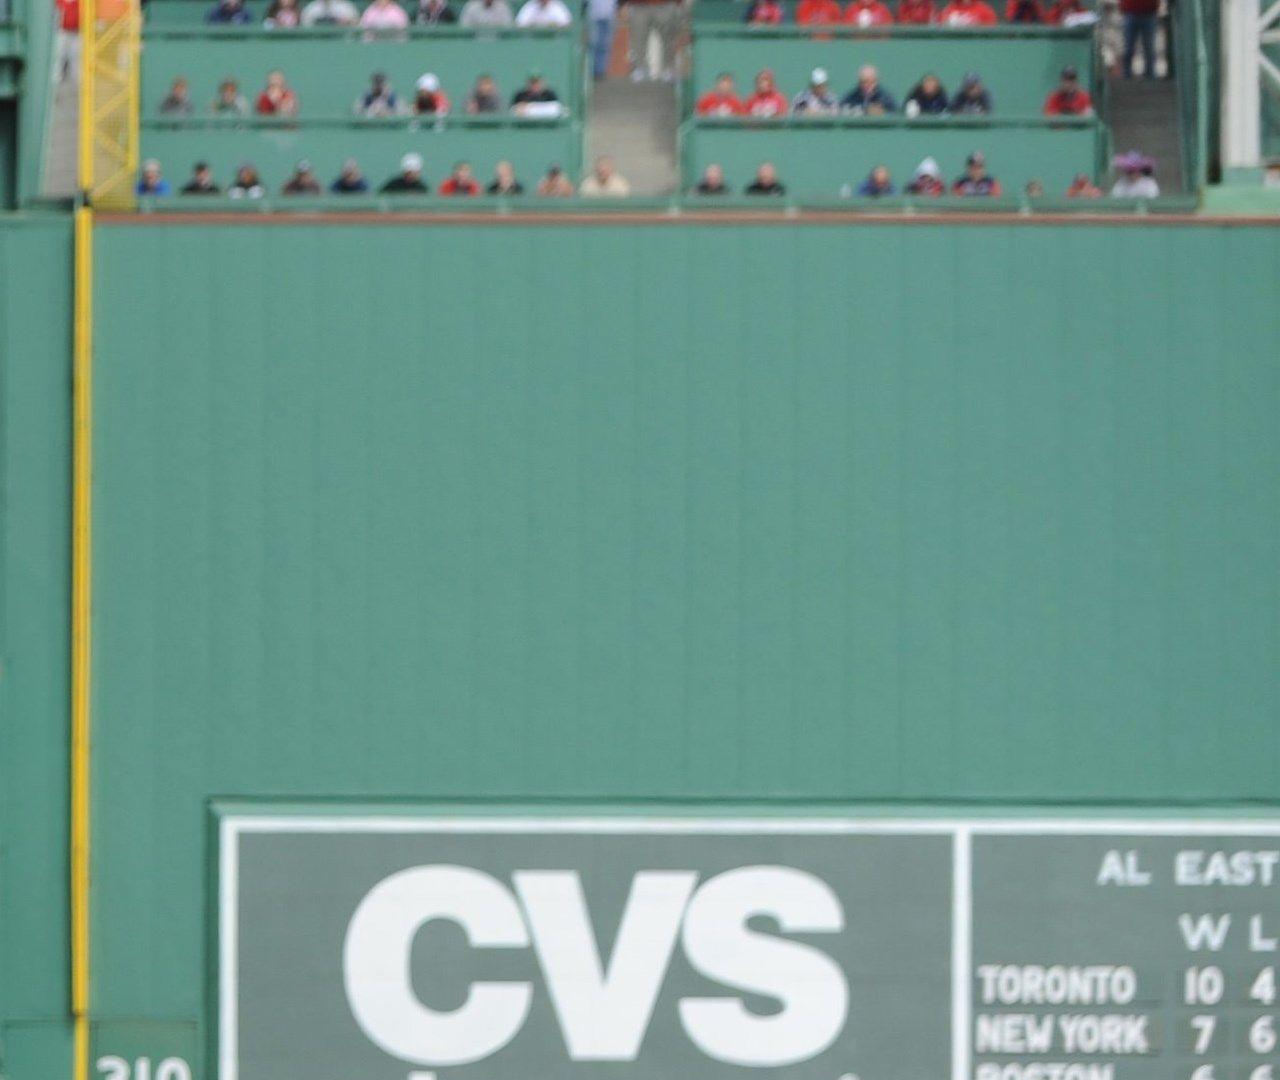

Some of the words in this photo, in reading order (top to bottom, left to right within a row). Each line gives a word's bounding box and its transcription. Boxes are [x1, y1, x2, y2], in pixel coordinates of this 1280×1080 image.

[1096, 850, 1152, 886] AL
[1174, 850, 1279, 886] EAST
[1178, 913, 1230, 951] W
[1249, 913, 1277, 952] L
[342, 864, 850, 1067] CVS
[978, 964, 1135, 1005] TORONTO
[1185, 966, 1223, 1005] 10
[1250, 966, 1275, 1005] 4
[976, 1014, 1052, 1053] NEW
[1058, 1014, 1149, 1053] YORK
[1190, 1015, 1217, 1054] 7
[1250, 1015, 1276, 1053] 6
